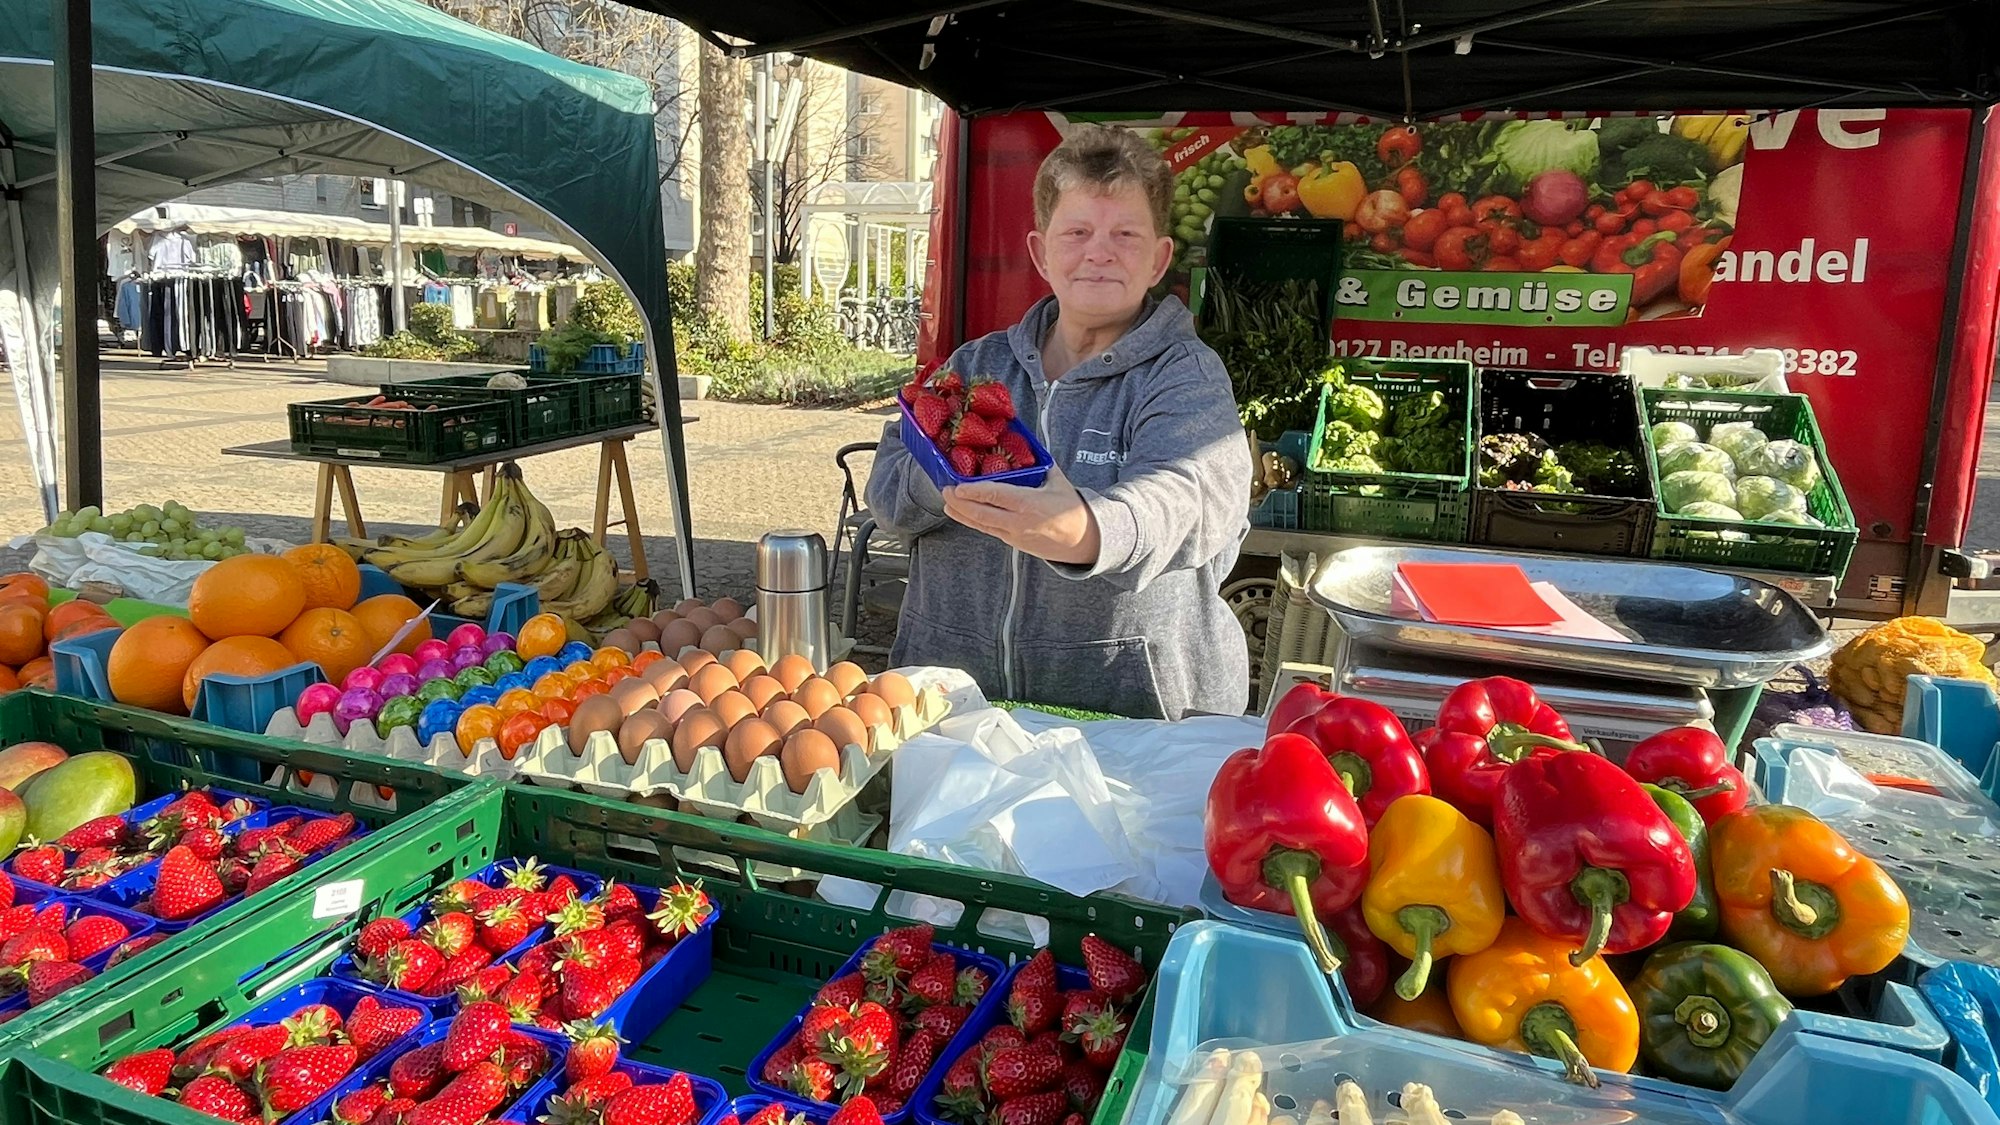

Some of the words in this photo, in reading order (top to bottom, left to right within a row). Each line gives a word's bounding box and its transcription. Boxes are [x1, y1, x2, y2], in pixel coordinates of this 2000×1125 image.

[1174, 134, 1210, 163] frisch
[1335, 277, 1368, 305] &
[1396, 279, 1618, 312] Gemüse
[1583, 727, 1640, 739] Verkaufspreis
